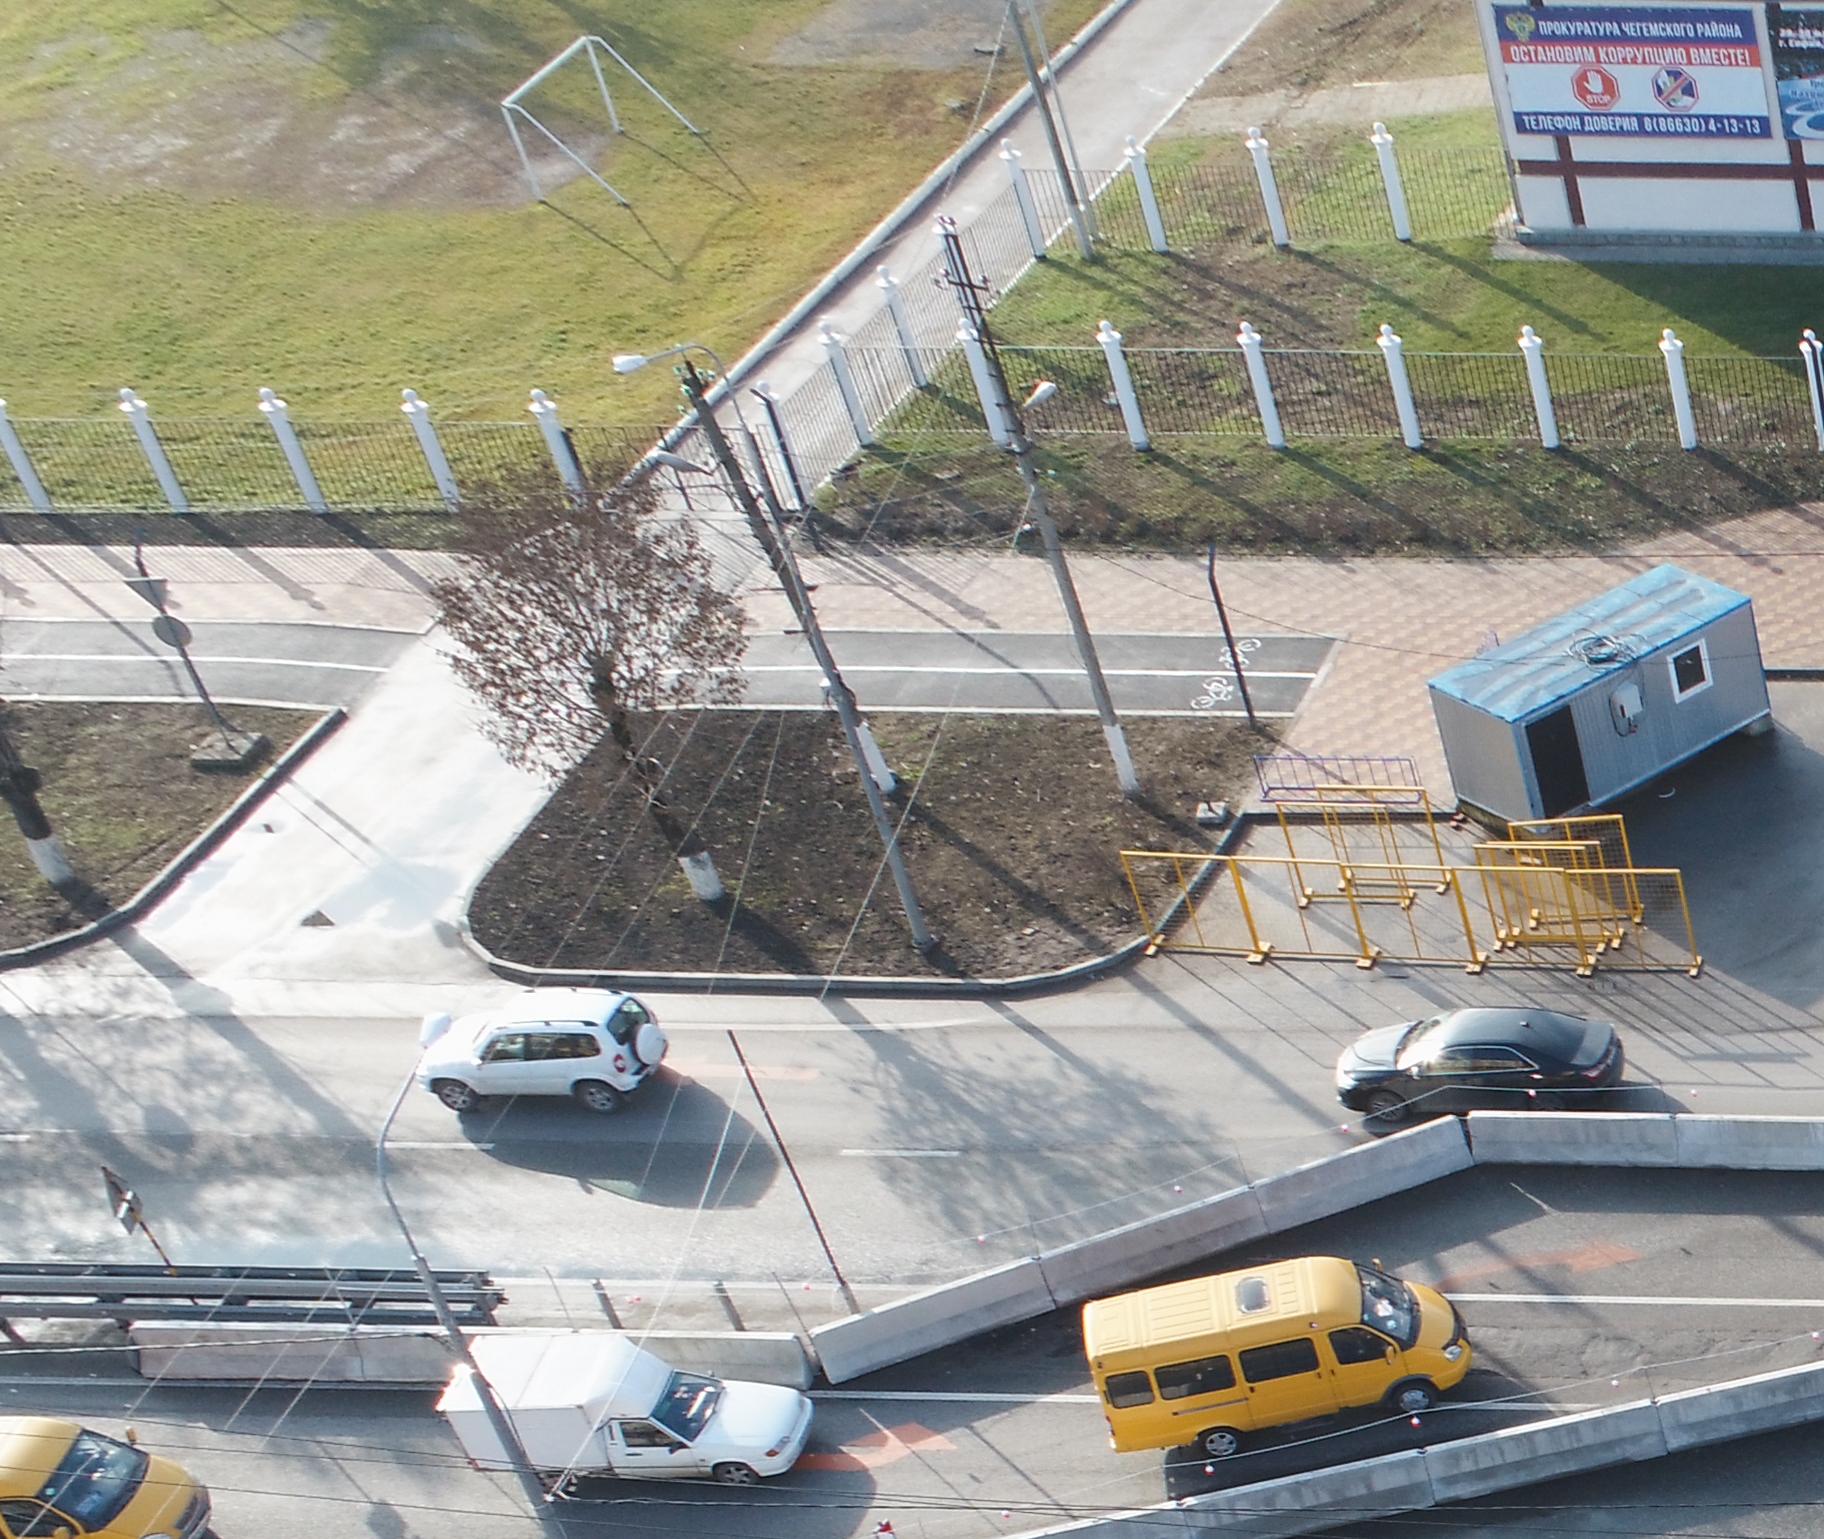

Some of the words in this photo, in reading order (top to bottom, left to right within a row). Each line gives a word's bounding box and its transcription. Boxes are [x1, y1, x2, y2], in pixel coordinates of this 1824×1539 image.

[1538, 20, 1620, 37] ПРОКУРАТУРА
[1621, 21, 1695, 38] ЧЕГЕМСКОГО
[1696, 21, 1743, 39] РАЙОНА
[1510, 45, 1596, 64] ОСТАНОВИМ
[1600, 46, 1689, 66] КОРРУПЦИЮ
[1690, 48, 1751, 67] ВМЕСТЕ!
[1586, 94, 1611, 104] STOP
[1522, 115, 1581, 132] ТЕЛЕФОН
[1583, 116, 1639, 133] ДОВЕРИЯ
[1708, 119, 1761, 134] 4-13-13
